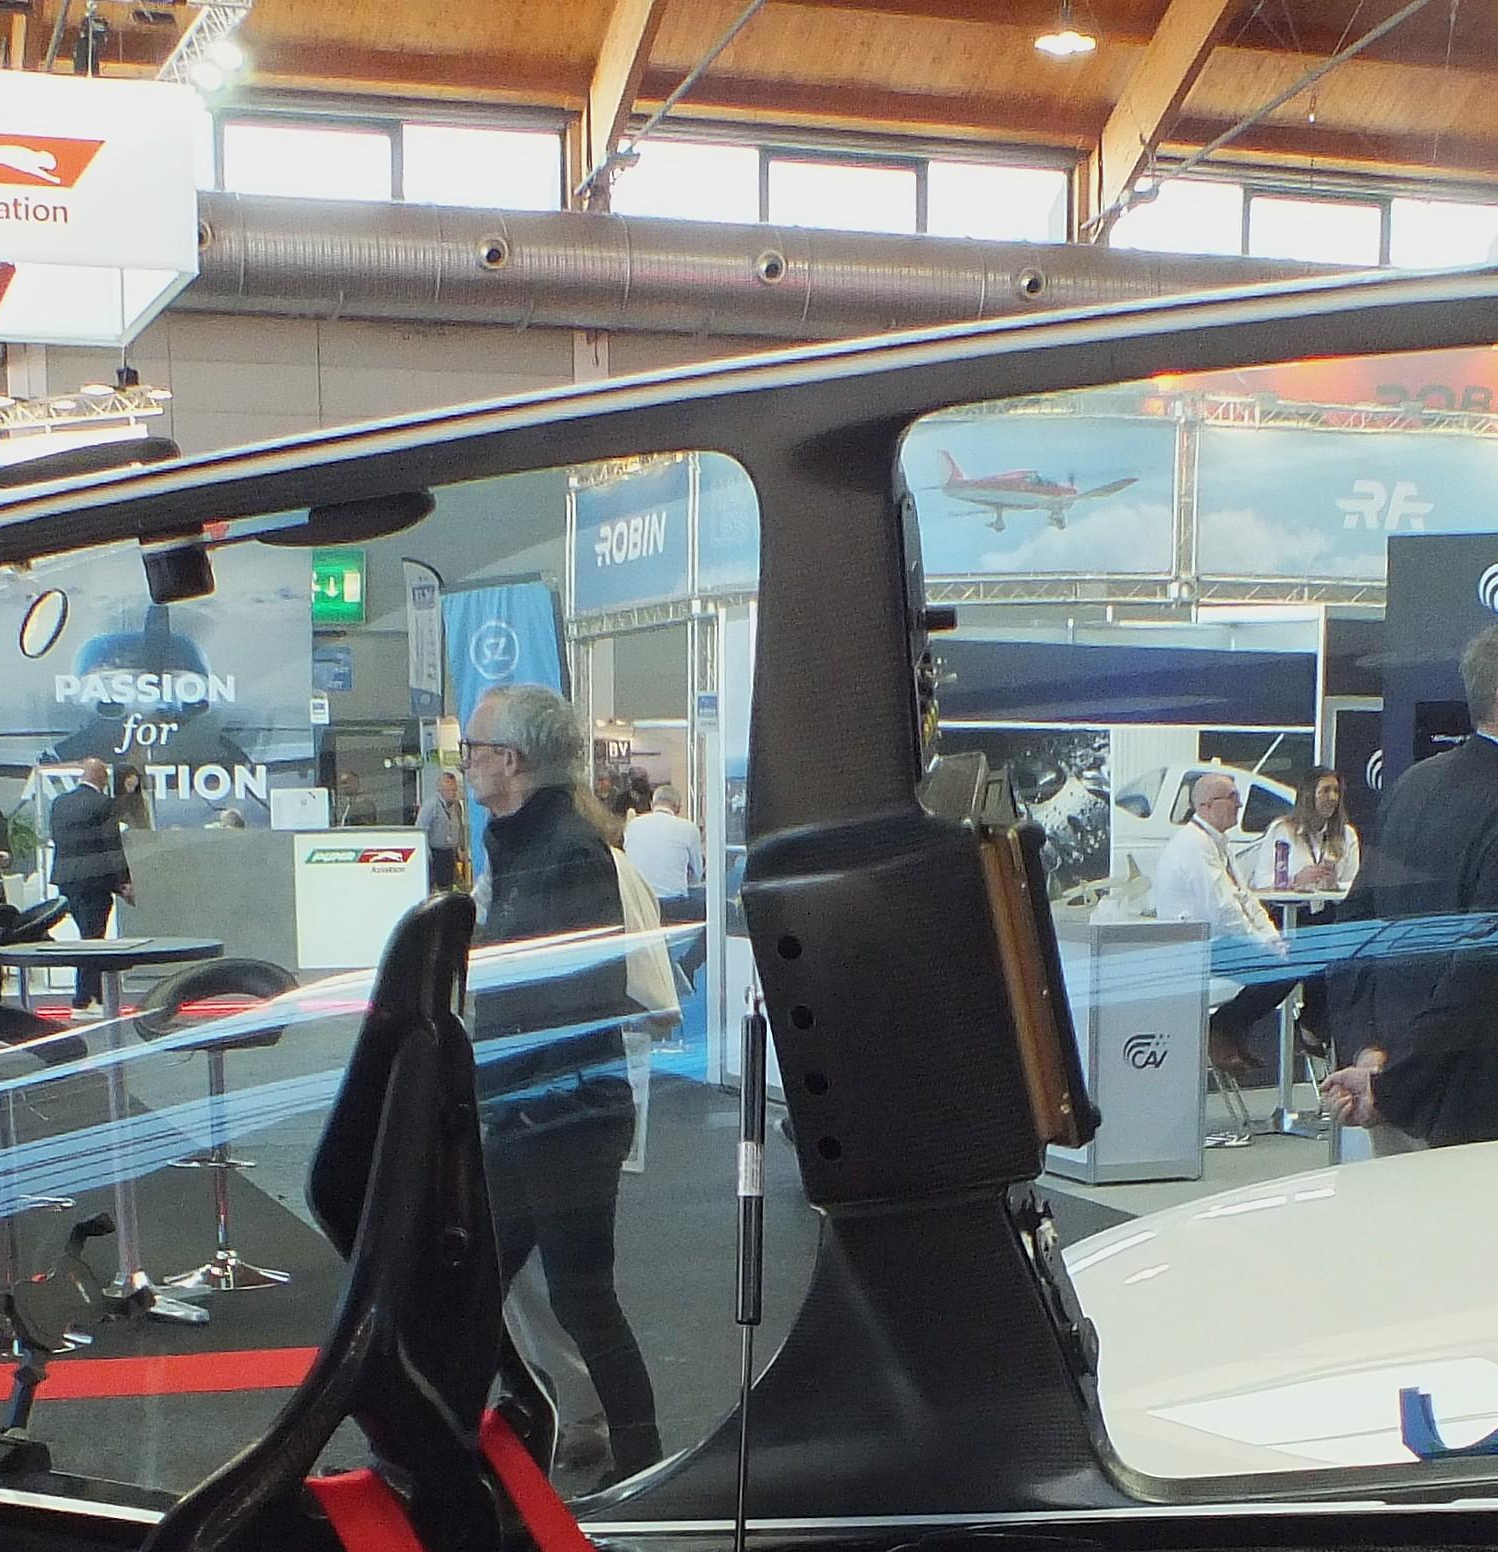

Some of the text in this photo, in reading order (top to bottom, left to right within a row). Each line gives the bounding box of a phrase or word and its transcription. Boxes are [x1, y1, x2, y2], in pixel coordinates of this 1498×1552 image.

[595, 511, 667, 567] ROBIN
[54, 673, 236, 704] PASSION
[114, 713, 179, 754] for
